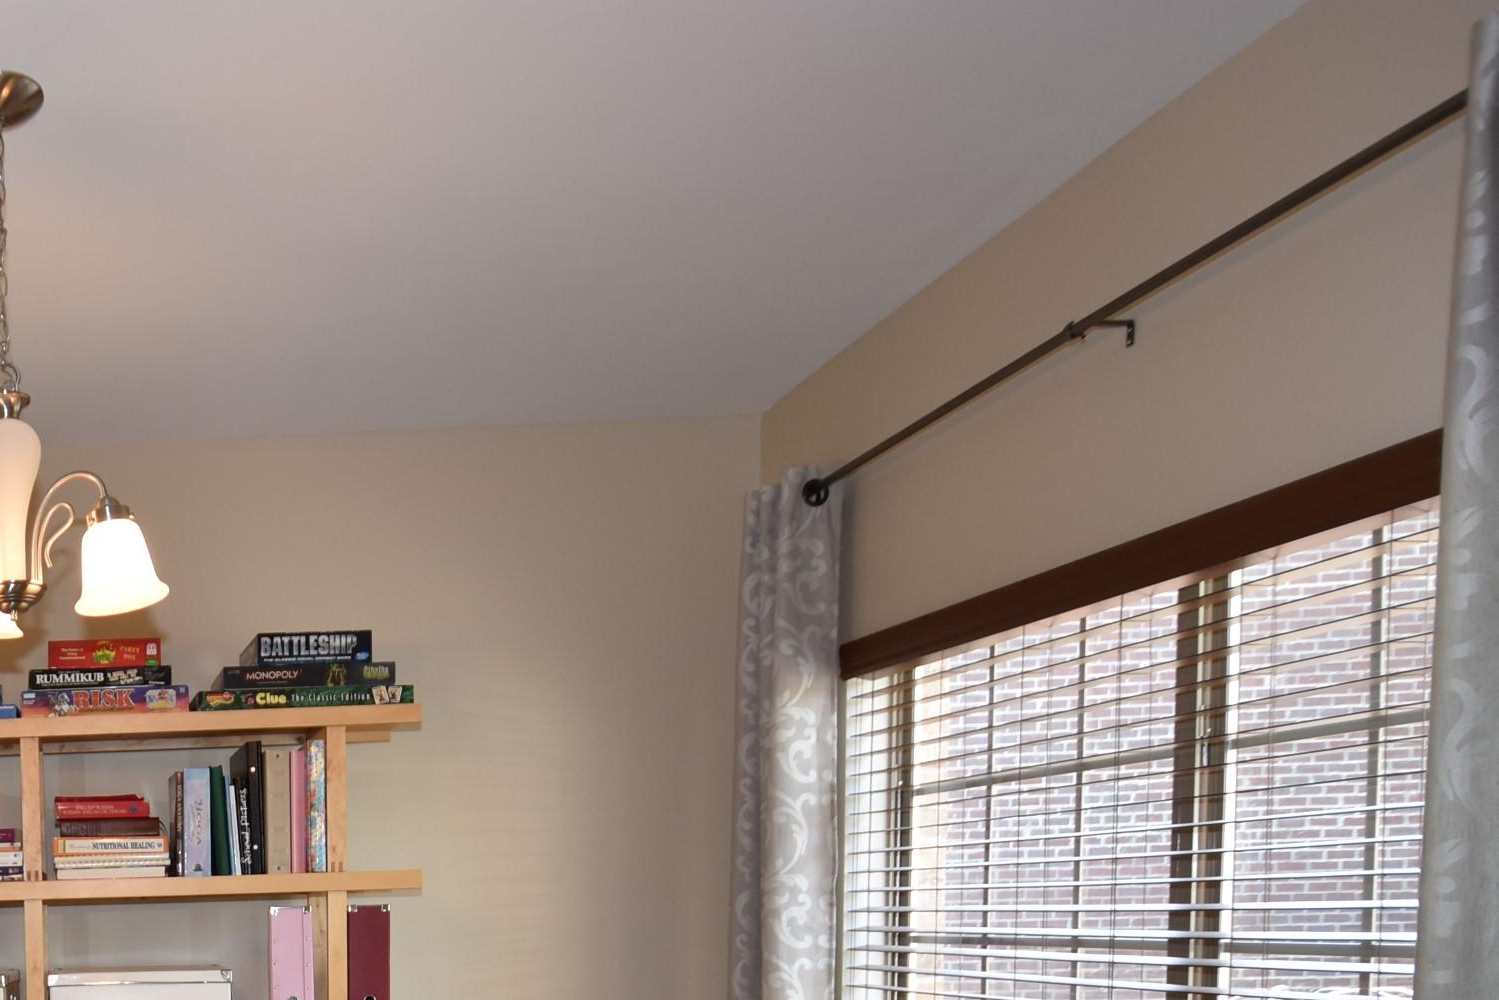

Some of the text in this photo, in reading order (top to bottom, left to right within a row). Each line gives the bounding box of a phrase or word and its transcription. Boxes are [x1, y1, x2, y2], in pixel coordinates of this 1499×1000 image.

[261, 634, 357, 656] BATTLESHIP
[35, 672, 104, 685] RUMMIKUB
[246, 669, 299, 681] MONOPOLY
[71, 688, 135, 709] RISK
[255, 692, 287, 705] Clue
